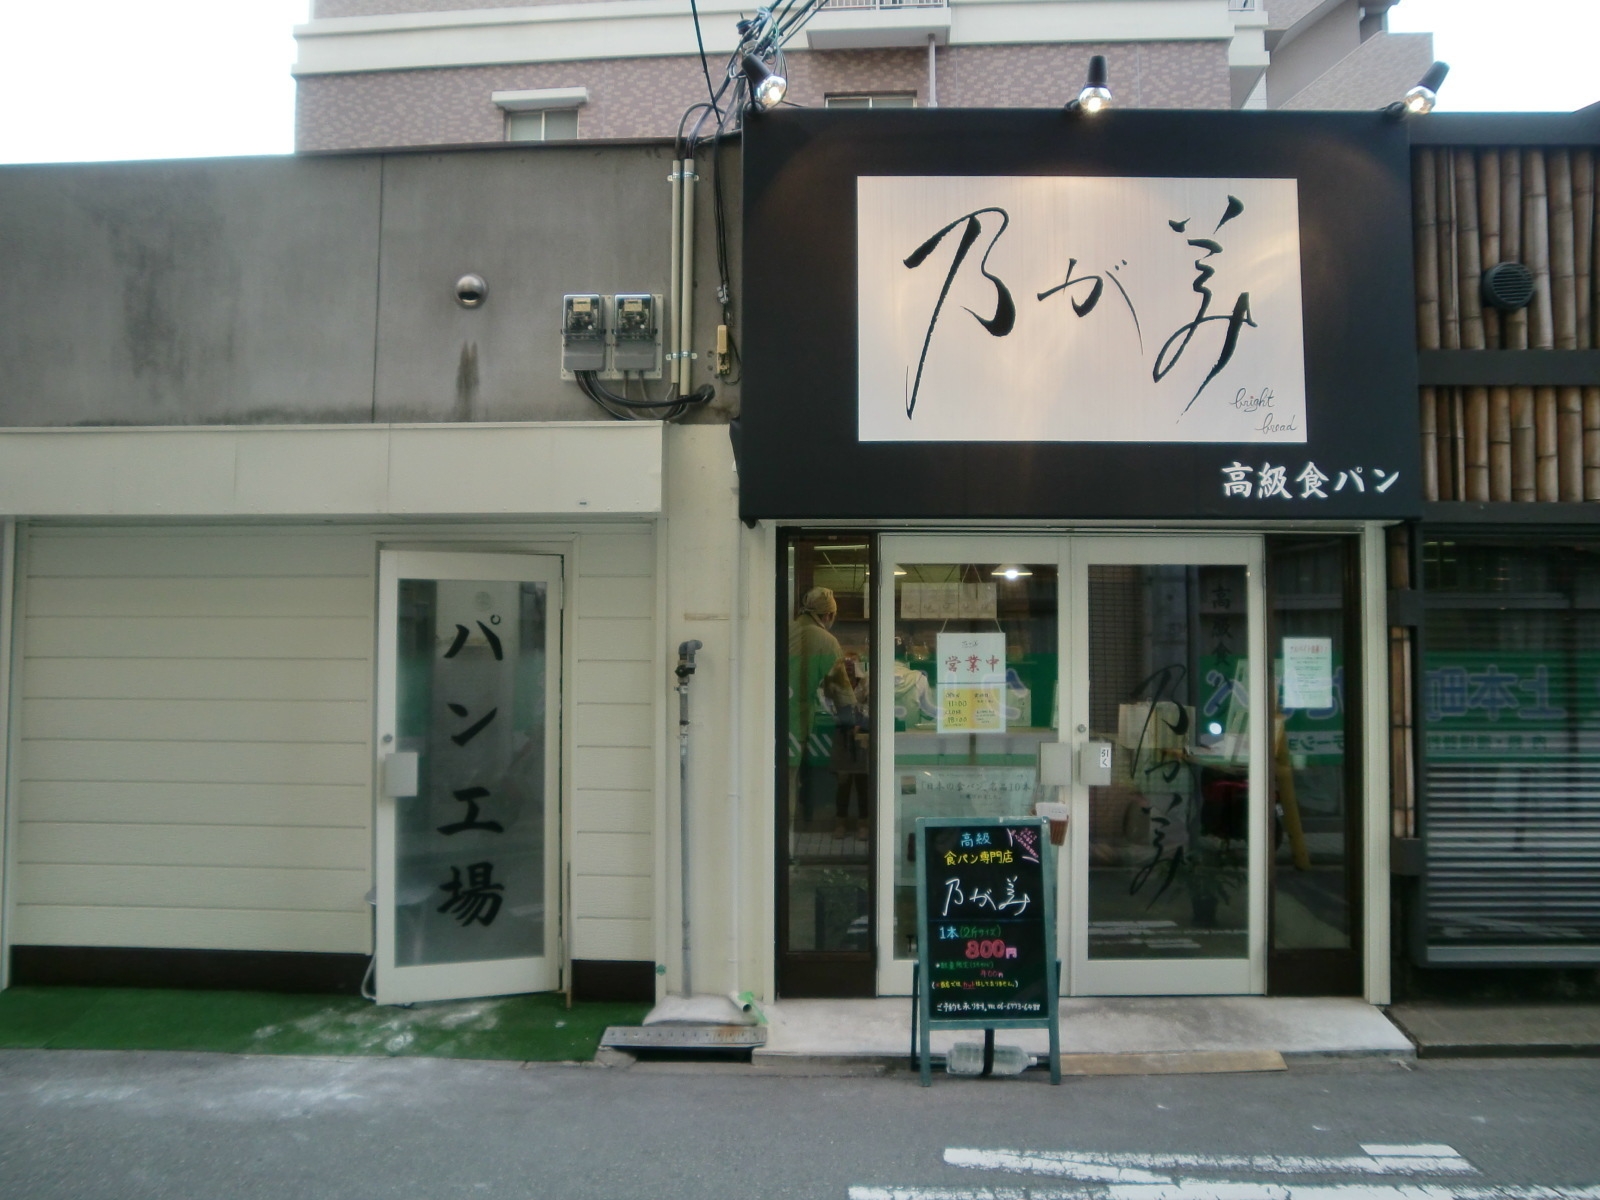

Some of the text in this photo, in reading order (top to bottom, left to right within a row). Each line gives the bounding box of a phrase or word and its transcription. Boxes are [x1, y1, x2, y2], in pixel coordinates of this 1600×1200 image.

[903, 195, 1258, 423] 乃が美
[1228, 388, 1275, 412] bright
[1255, 413, 1298, 434] bread
[1221, 462, 1400, 499] 高級食パン
[945, 654, 999, 673] 営業中
[1101, 749, 1109, 767] 引く
[437, 614, 505, 928] パン工場
[961, 832, 992, 848] 高級
[944, 850, 1014, 866] 食パン専門店
[942, 875, 1031, 917] 乃が美
[965, 939, 1019, 960] 800円
